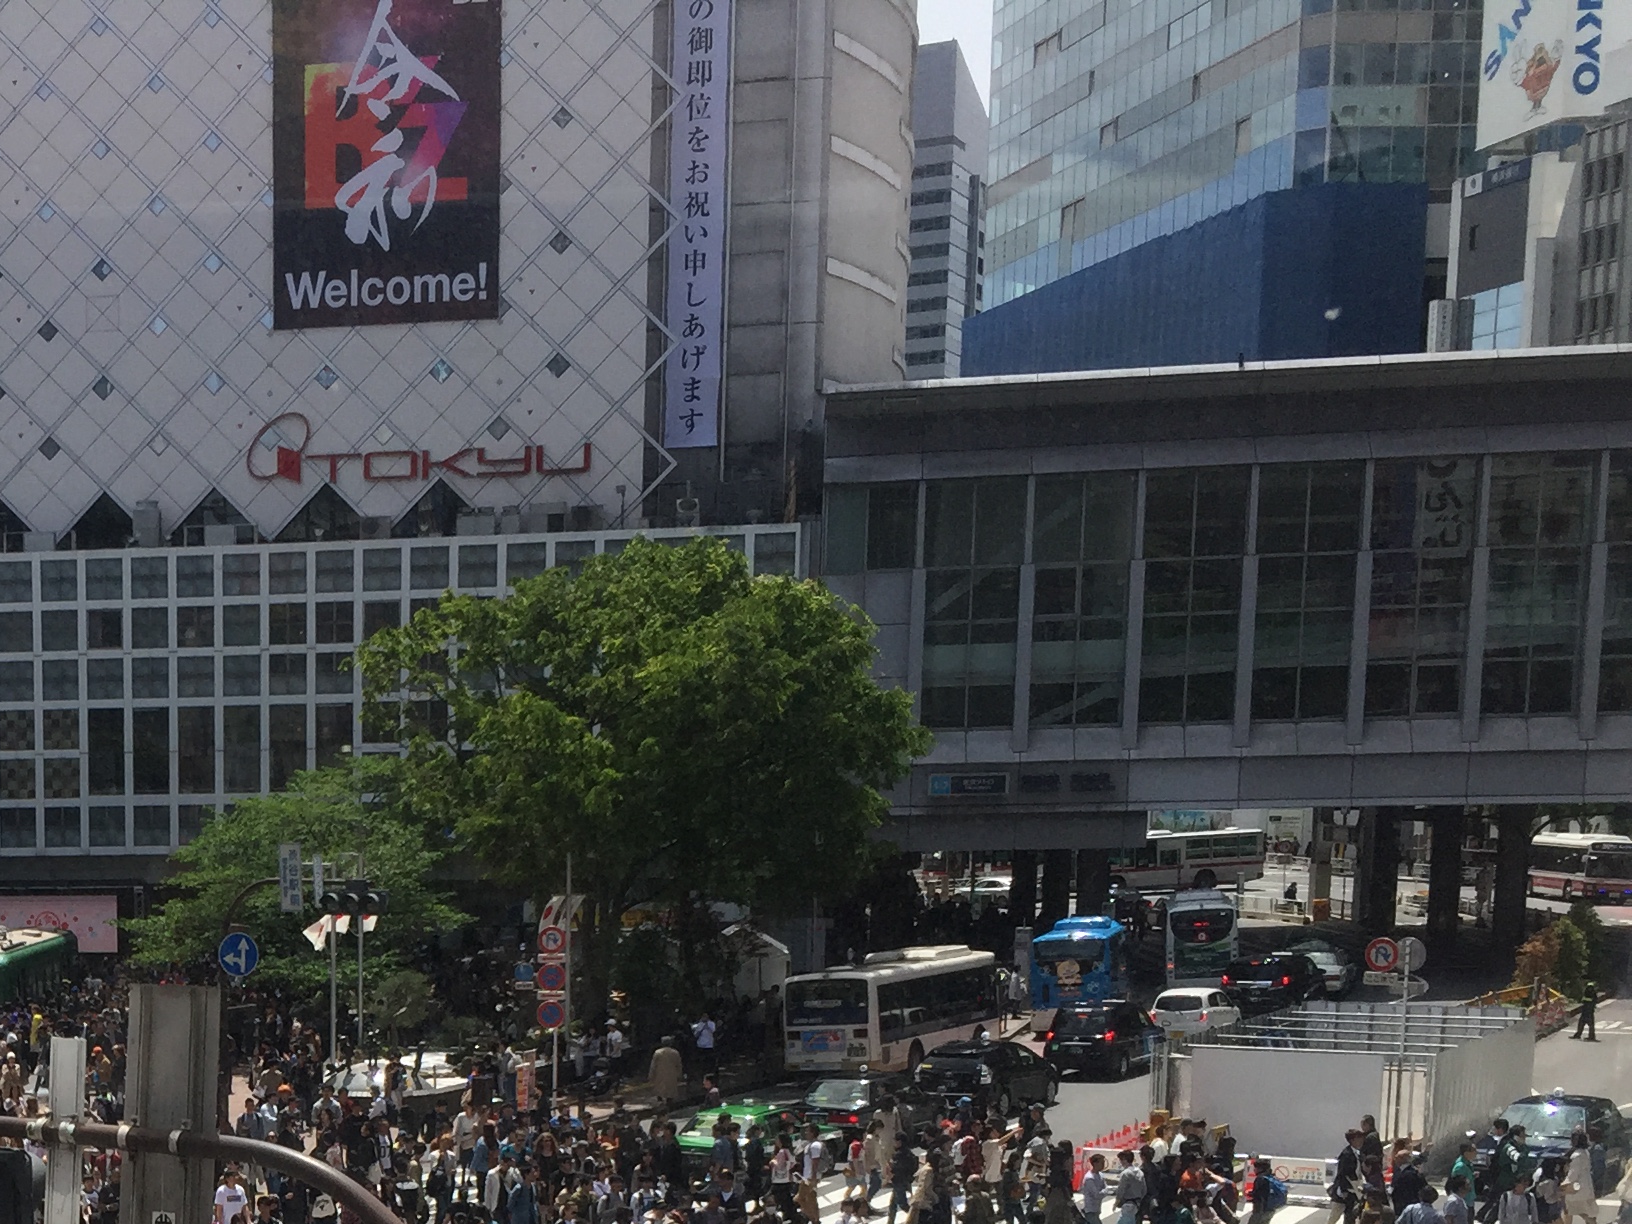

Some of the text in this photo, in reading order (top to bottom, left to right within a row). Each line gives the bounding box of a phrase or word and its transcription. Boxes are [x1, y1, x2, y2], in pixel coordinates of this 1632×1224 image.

[334, 0, 461, 252] 令和
[285, 262, 489, 311] Welcome!
[305, 442, 592, 484] TOKYU
